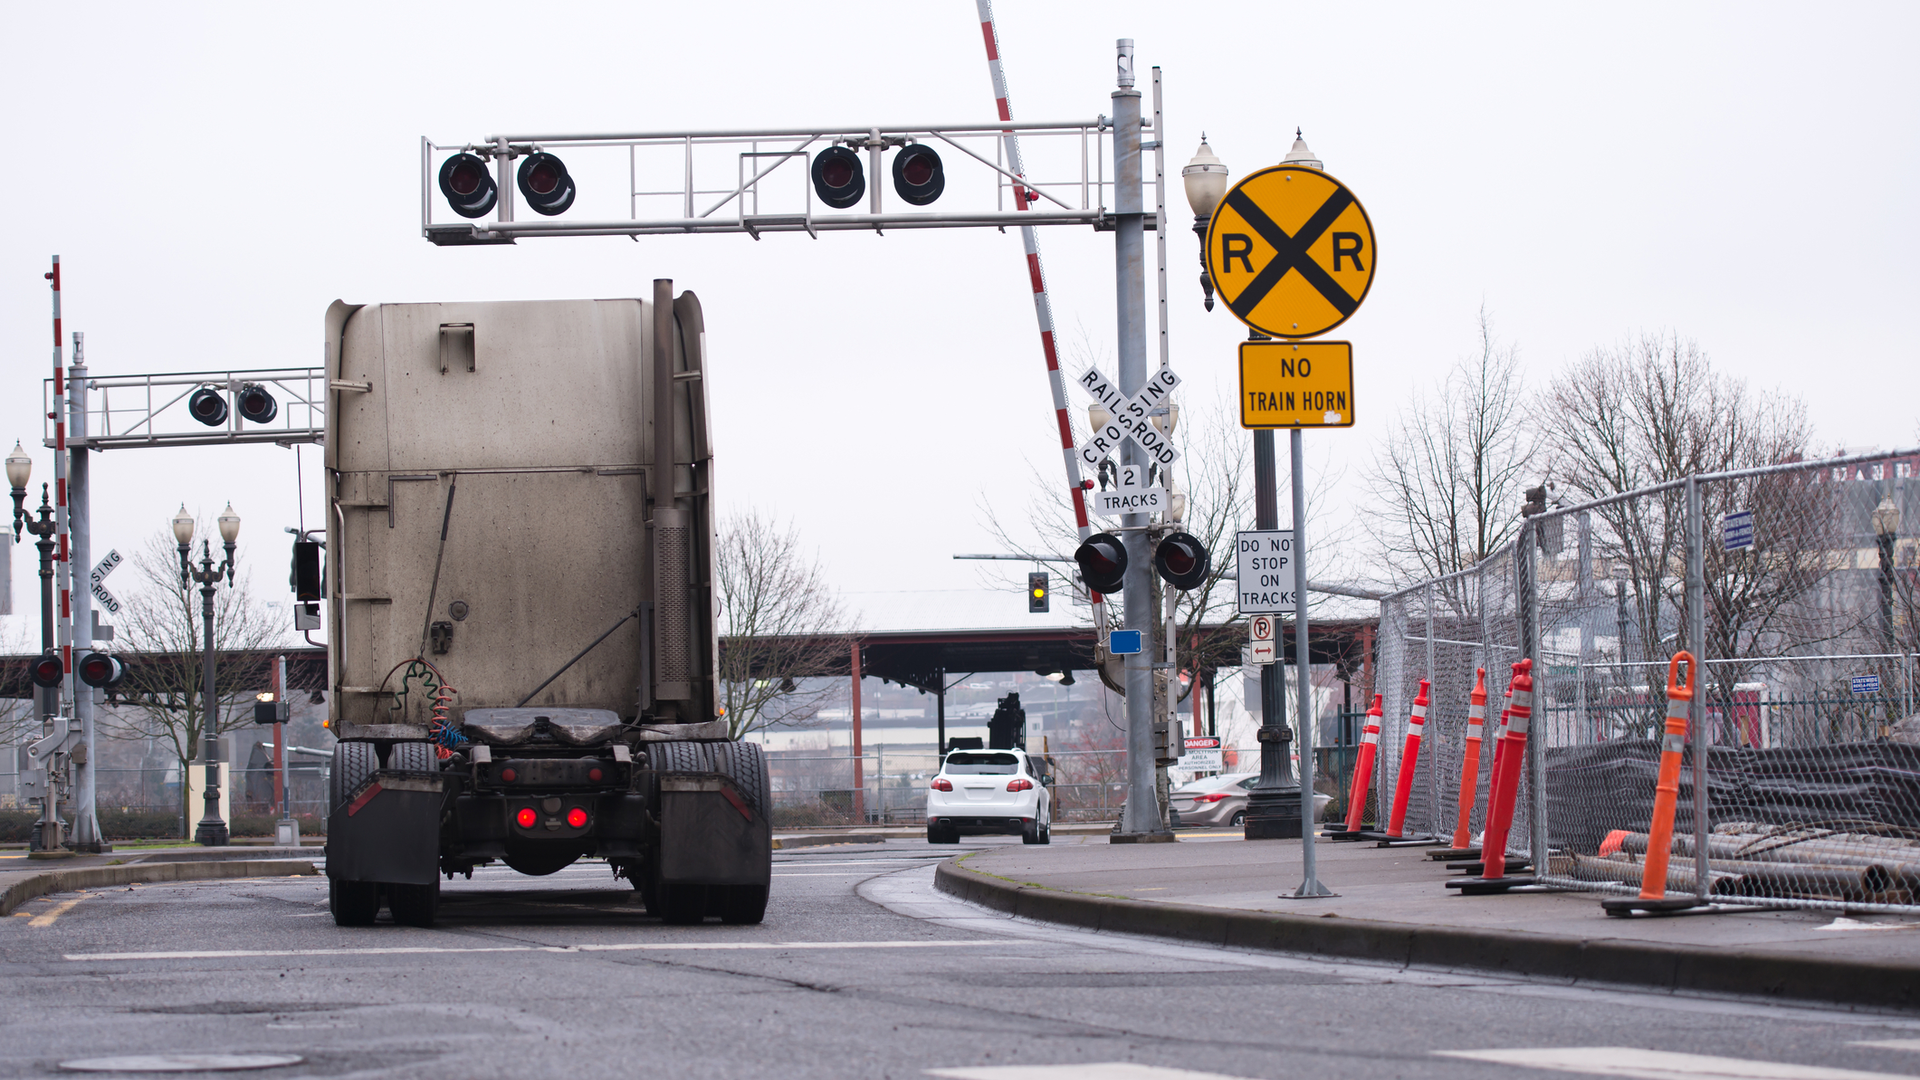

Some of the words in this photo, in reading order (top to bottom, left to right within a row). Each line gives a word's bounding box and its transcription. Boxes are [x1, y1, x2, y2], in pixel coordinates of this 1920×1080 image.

[1222, 233, 1255, 273] R
[1332, 232, 1365, 272] R
[1281, 358, 1311, 377] NO
[1249, 392, 1295, 411] TRAIN
[1303, 391, 1346, 410] HORN
[1083, 371, 1175, 463] CROSSING
[1124, 470, 1135, 485] 2
[1104, 493, 1158, 509] TRACKS
[1241, 540, 1259, 552] DO
[1271, 539, 1294, 552] NO
[91, 553, 120, 586] SING
[1252, 557, 1288, 570] STOP
[1260, 574, 1279, 587] ON
